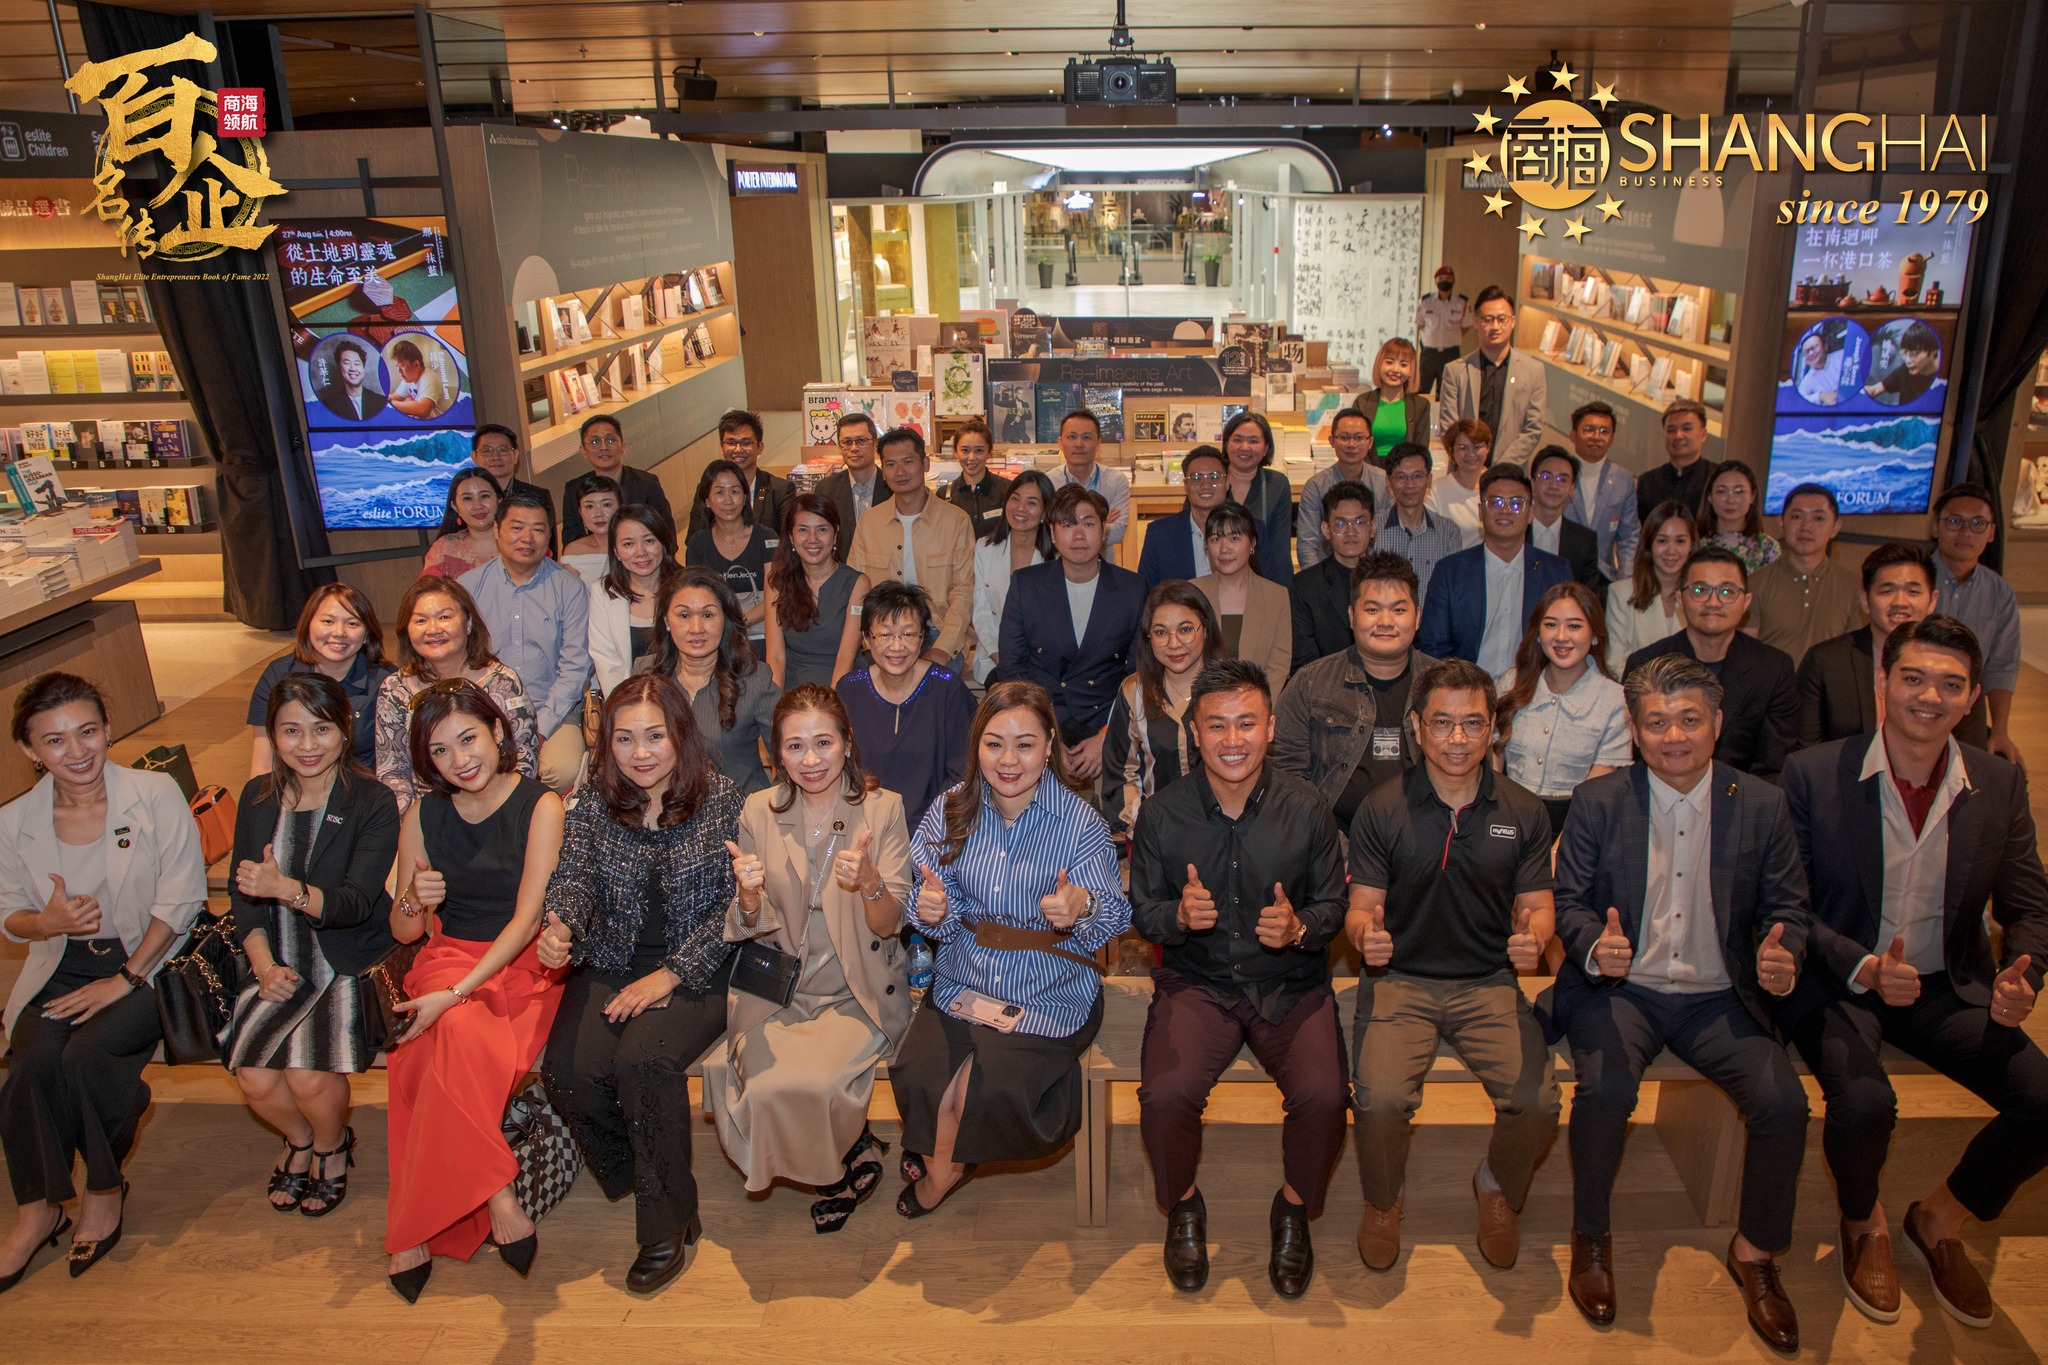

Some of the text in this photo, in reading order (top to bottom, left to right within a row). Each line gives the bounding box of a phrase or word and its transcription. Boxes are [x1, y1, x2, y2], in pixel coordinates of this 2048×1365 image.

[25, 129, 52, 142] eslite
[28, 144, 69, 157] Children
[737, 171, 760, 188] PORTER
[285, 241, 397, 263] 從土地到靈魂
[1802, 251, 1894, 270] 一杯港口茶
[290, 265, 382, 287] 的生命至美
[1165, 364, 1192, 380] Art
[1836, 491, 1890, 506] FORUM
[363, 507, 392, 519] eslite
